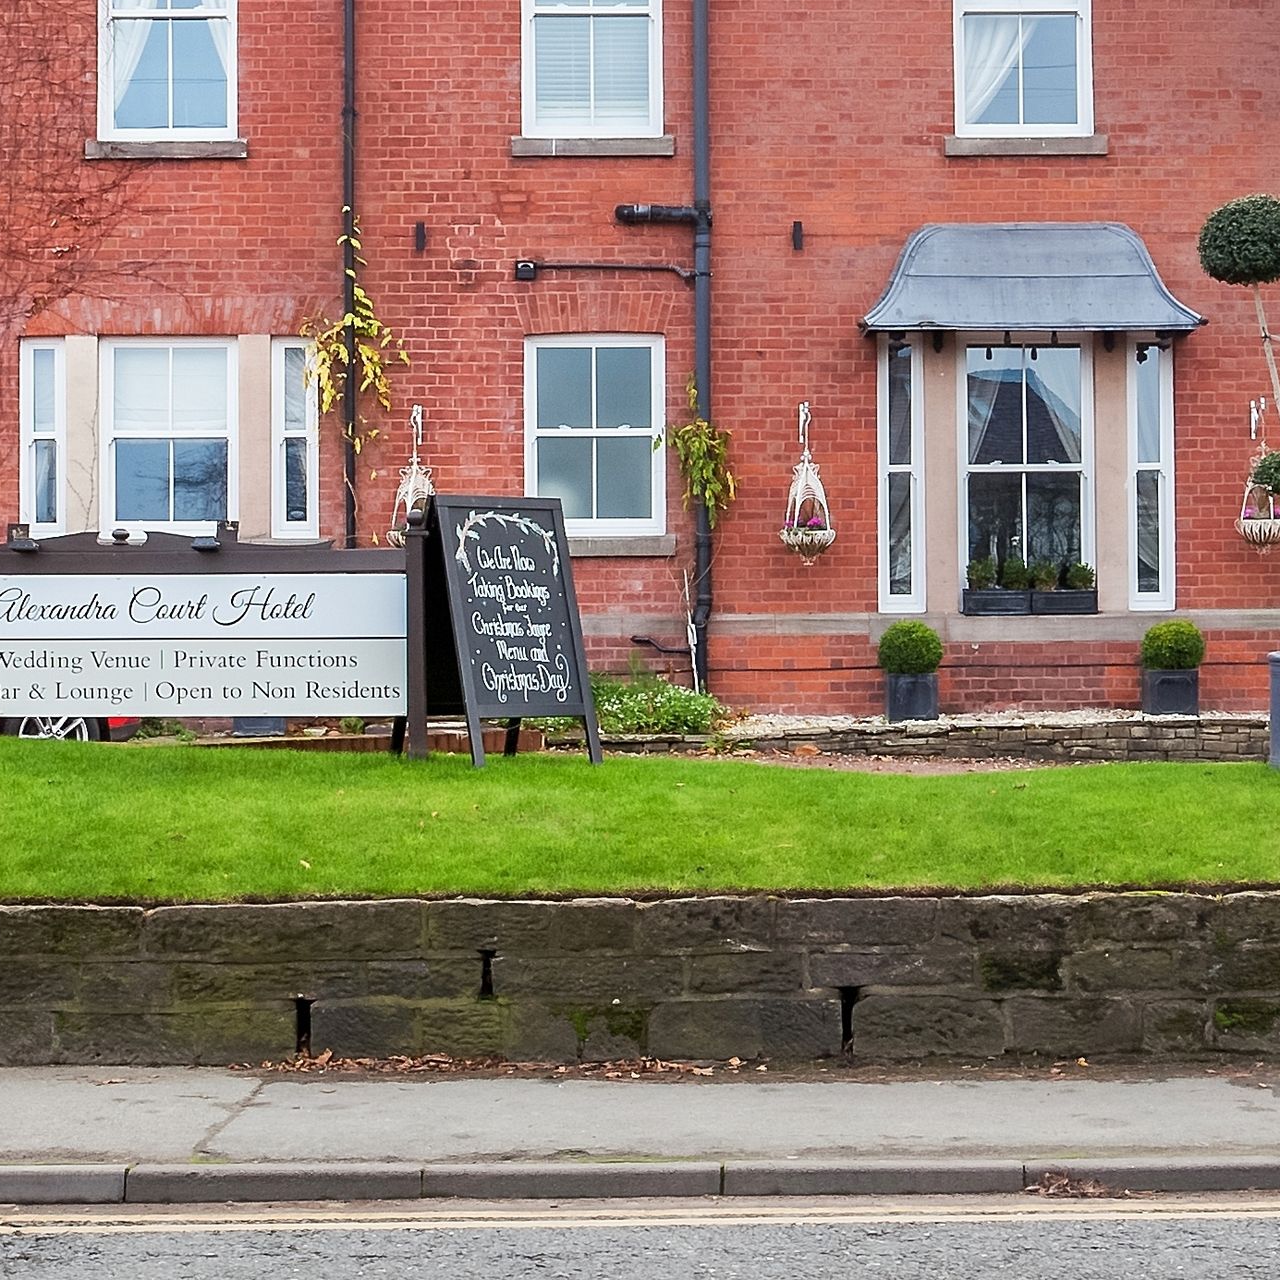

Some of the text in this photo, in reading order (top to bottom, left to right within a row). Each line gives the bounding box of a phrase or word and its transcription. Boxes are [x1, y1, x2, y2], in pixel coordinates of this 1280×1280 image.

[477, 544, 536, 571] We Are Now
[467, 572, 551, 607] Taking Bookings
[128, 586, 208, 624] Court
[212, 585, 317, 626] Hotel
[472, 611, 524, 638] Christmas
[90, 650, 151, 669] Venue
[173, 649, 247, 668] Private
[255, 649, 358, 668] Functions
[496, 640, 551, 662] Menu and
[28, 682, 47, 700] &
[55, 681, 134, 704] Lounge
[155, 681, 213, 704] Open
[222, 683, 242, 699] to
[251, 681, 296, 699] Non
[305, 680, 401, 699] Residents
[482, 662, 539, 703] Christmas
